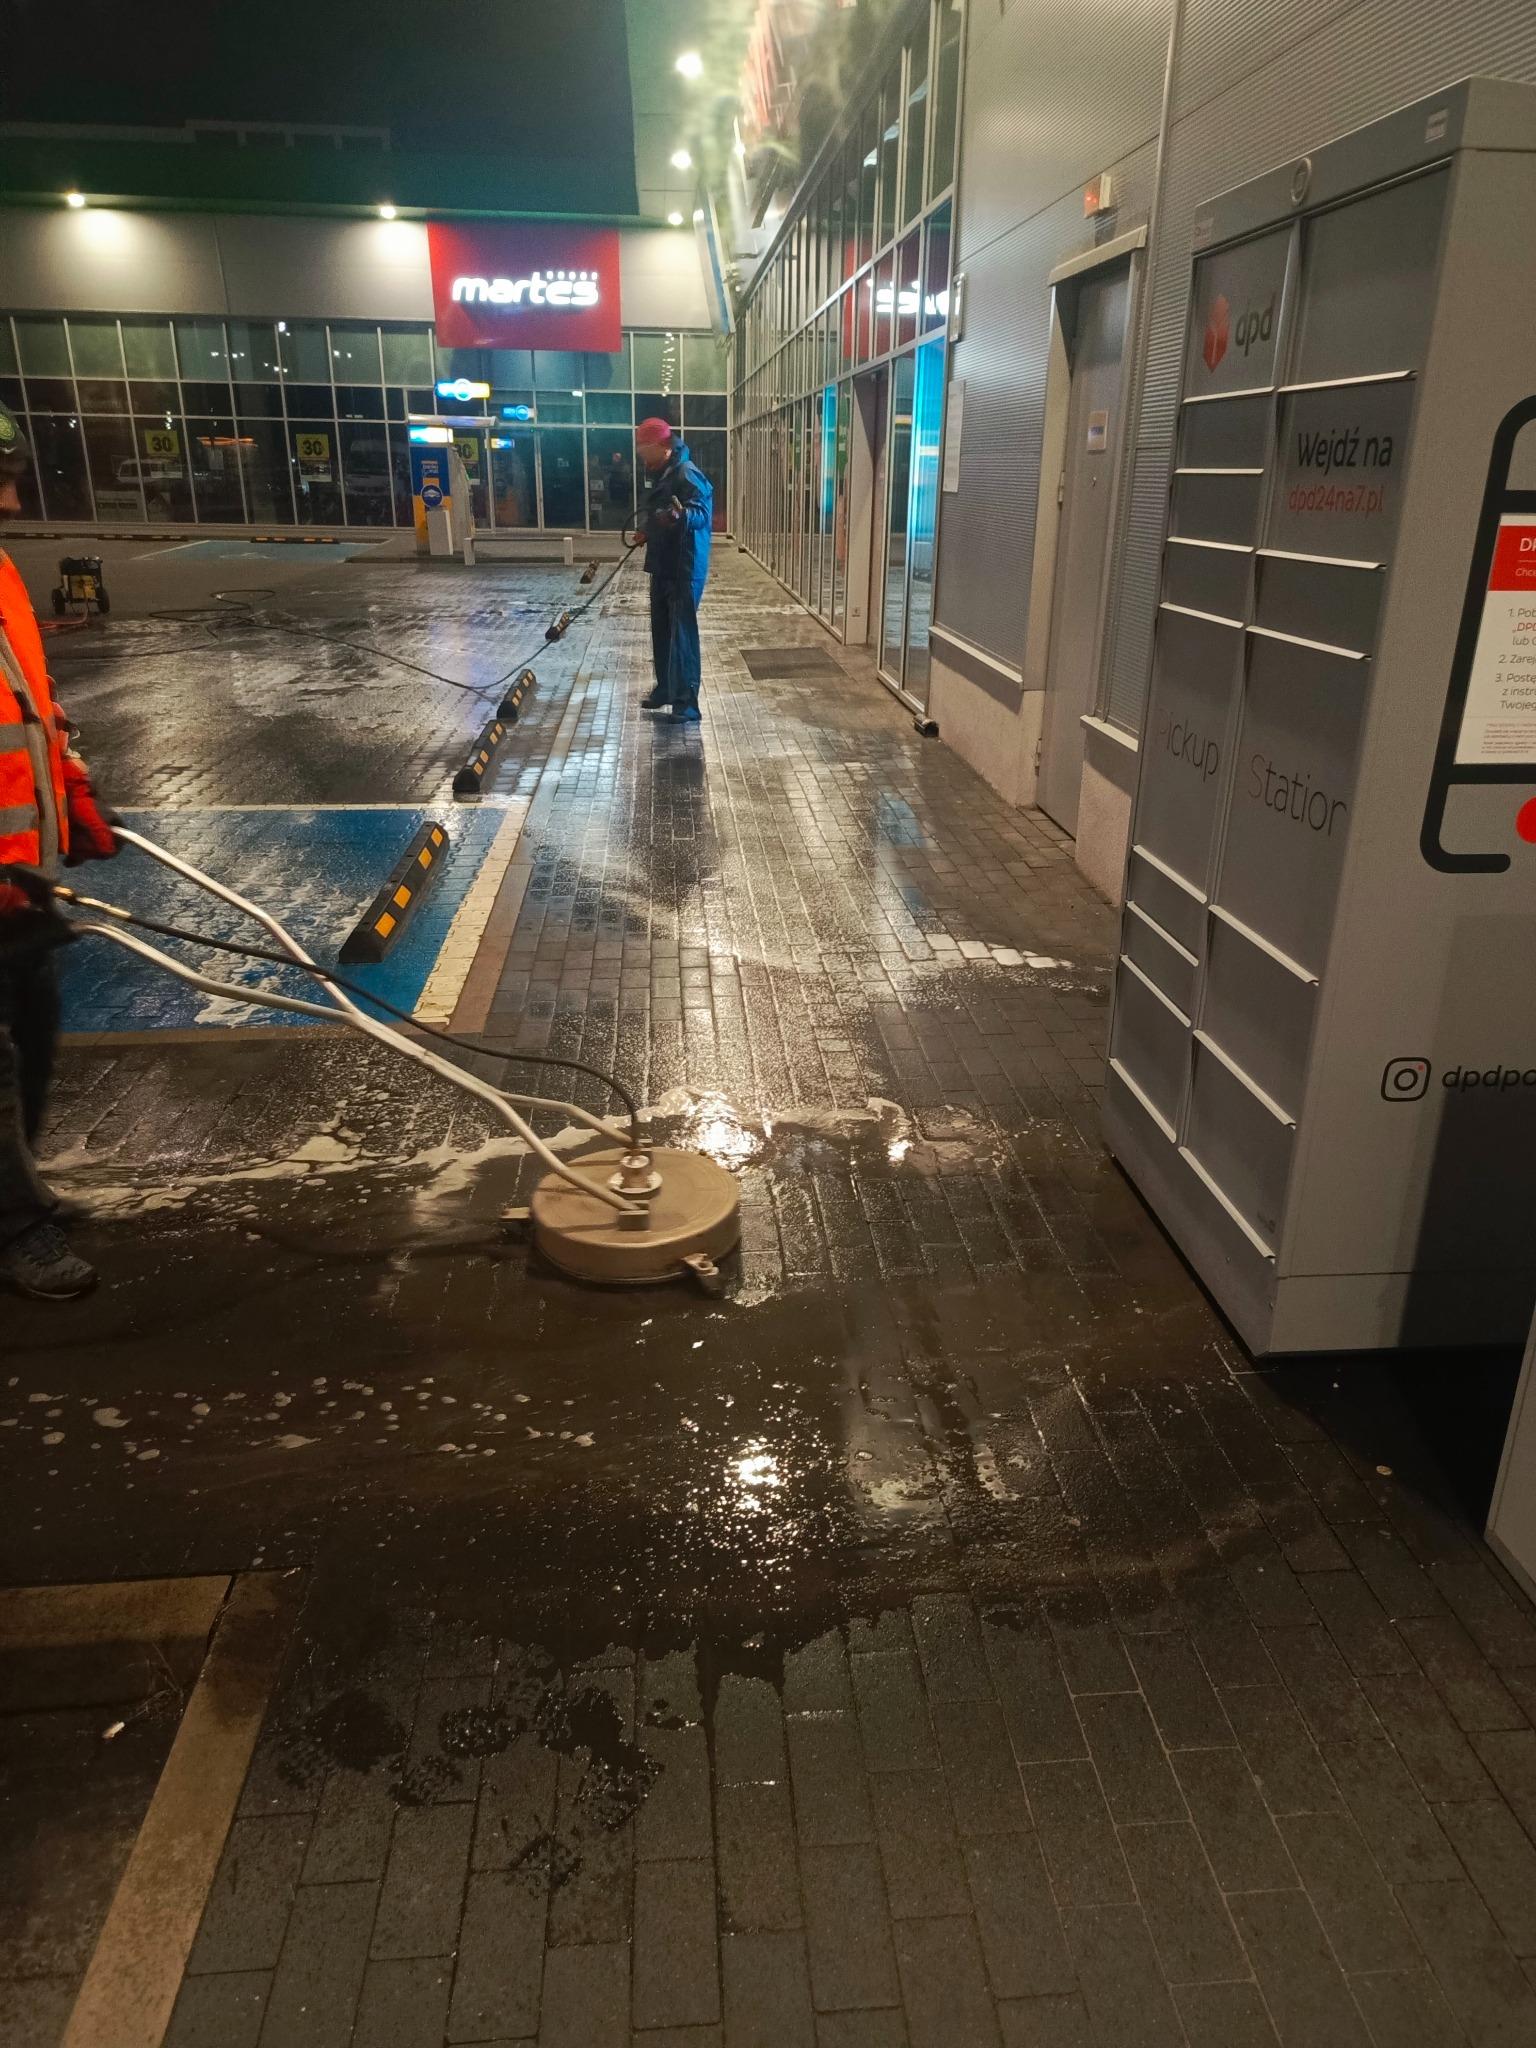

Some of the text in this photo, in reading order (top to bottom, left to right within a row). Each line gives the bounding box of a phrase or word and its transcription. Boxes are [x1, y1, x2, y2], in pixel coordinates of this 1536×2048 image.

[452, 271, 598, 306] martes
[1235, 291, 1276, 358] dpd
[152, 436, 173, 453] 30
[302, 439, 323, 456] 30
[1298, 426, 1393, 477] Wejdź na
[1289, 484, 1384, 518] dpd24na7.pl
[1512, 636, 1530, 646] lub
[1502, 687, 1536, 697] z instr
[1155, 708, 1219, 783] Pickup
